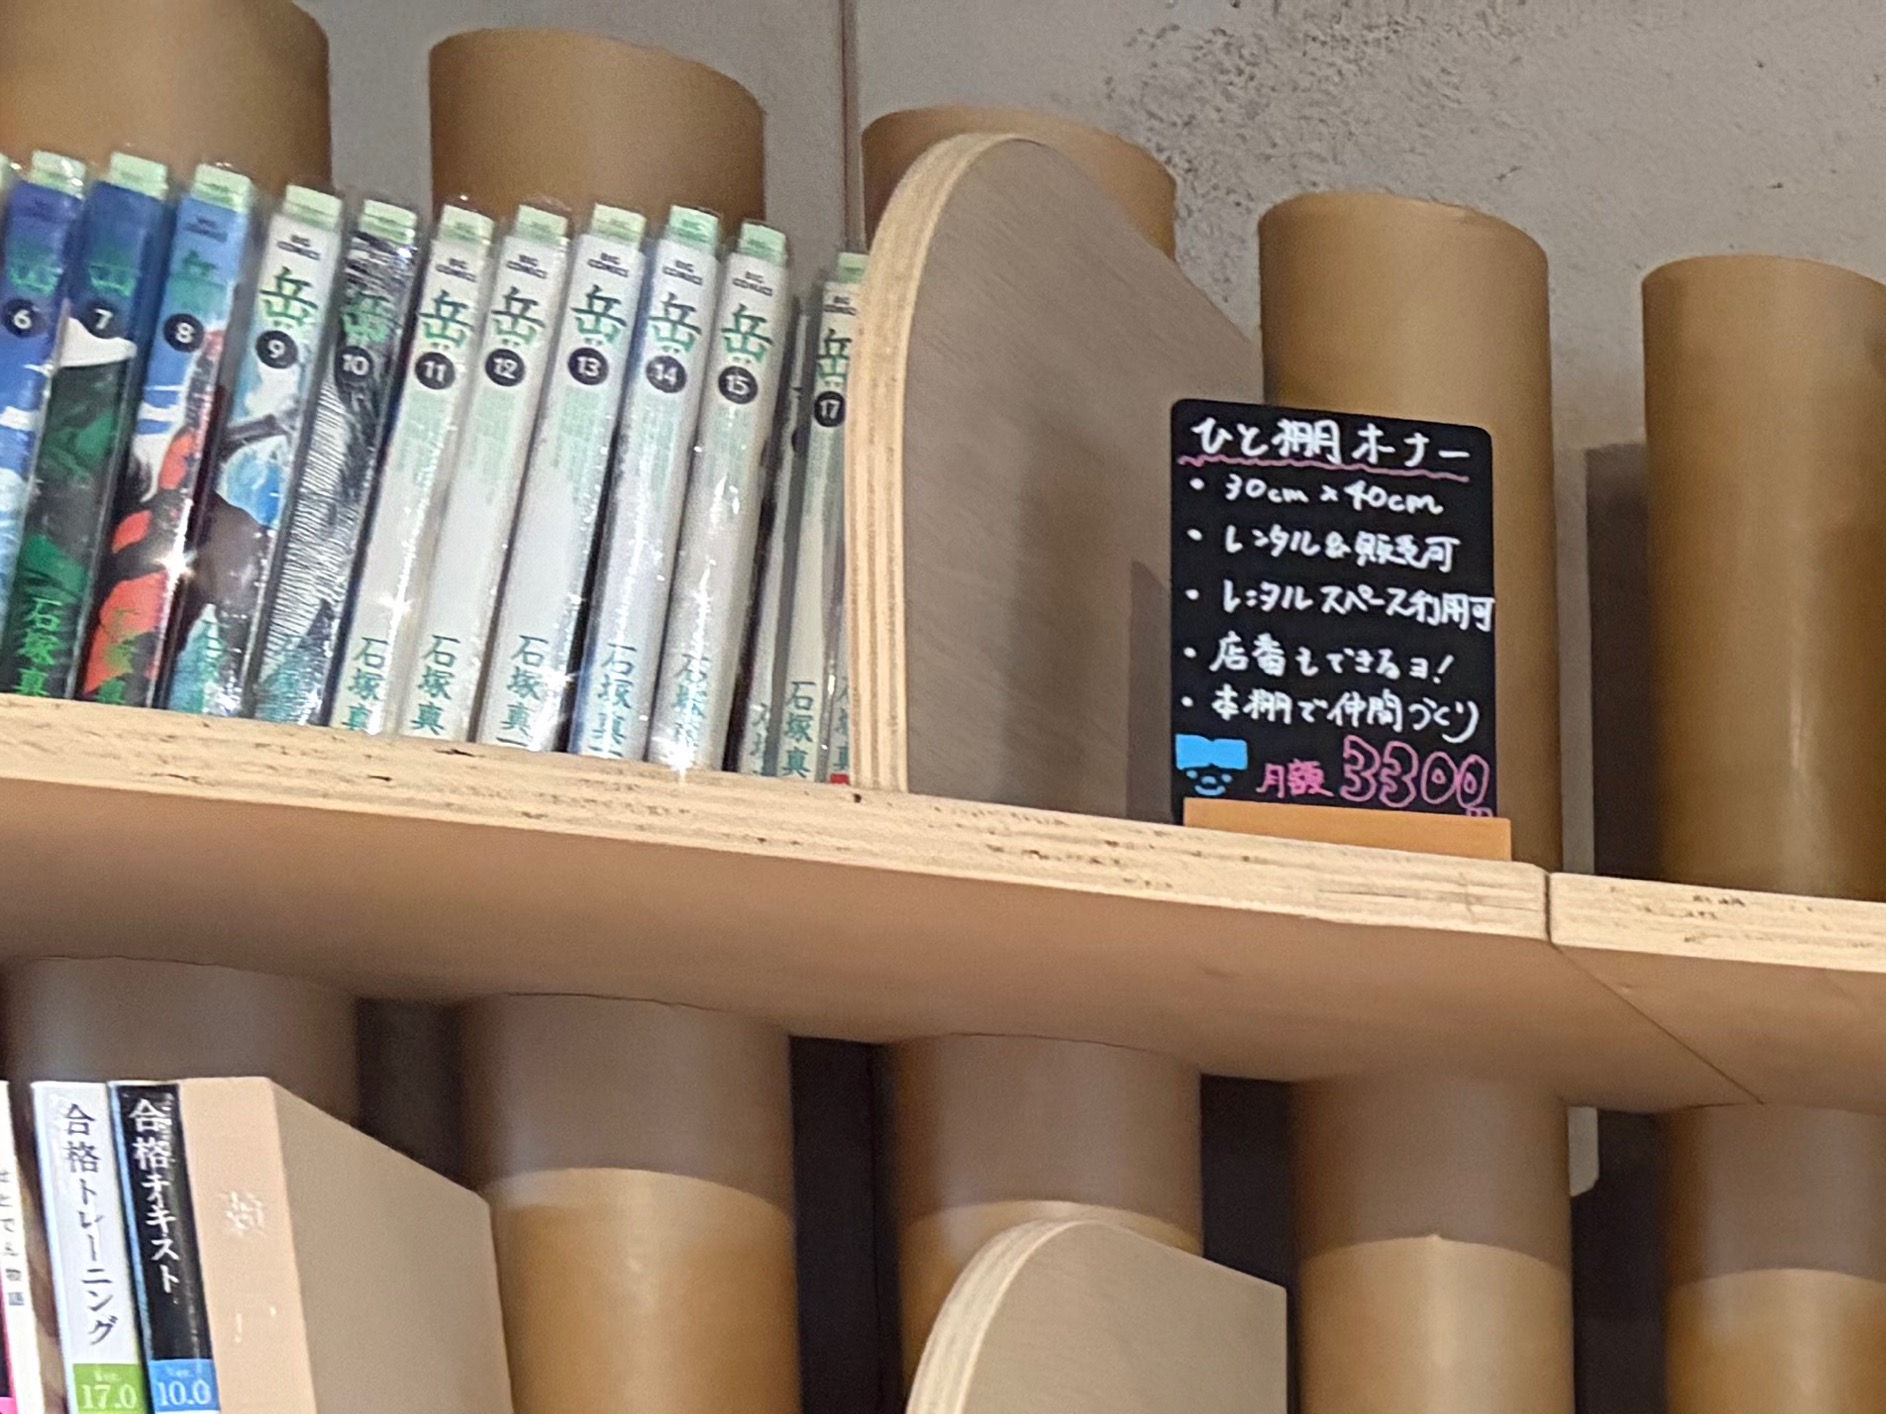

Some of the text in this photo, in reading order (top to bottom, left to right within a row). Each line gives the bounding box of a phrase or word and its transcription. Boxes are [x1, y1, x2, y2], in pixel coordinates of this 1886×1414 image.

[259, 266, 319, 328] 岳
[12, 308, 33, 330] 6
[94, 308, 114, 331] 7
[418, 288, 475, 348] 岳
[490, 286, 546, 345] 岳
[571, 284, 628, 346] 岳
[650, 291, 702, 353] 岳
[174, 321, 195, 344] 8
[721, 302, 774, 363] 岳
[267, 340, 286, 359] 9
[816, 328, 852, 382] 岳
[342, 353, 370, 376] 10
[422, 361, 447, 382] 11
[492, 357, 518, 379] 12
[576, 357, 600, 378] 13
[652, 364, 678, 386] 14
[724, 375, 749, 395] 15
[819, 401, 840, 420] 17
[1210, 684, 1481, 745] 本棚で仲間づくり
[1257, 735, 1492, 809] 月額 3300
[128, 1097, 180, 1295] 合格テキスト
[64, 1102, 119, 1346] 合格トレーニング
[80, 1384, 138, 1411] 17.0
[156, 1379, 212, 1408] 10.0
